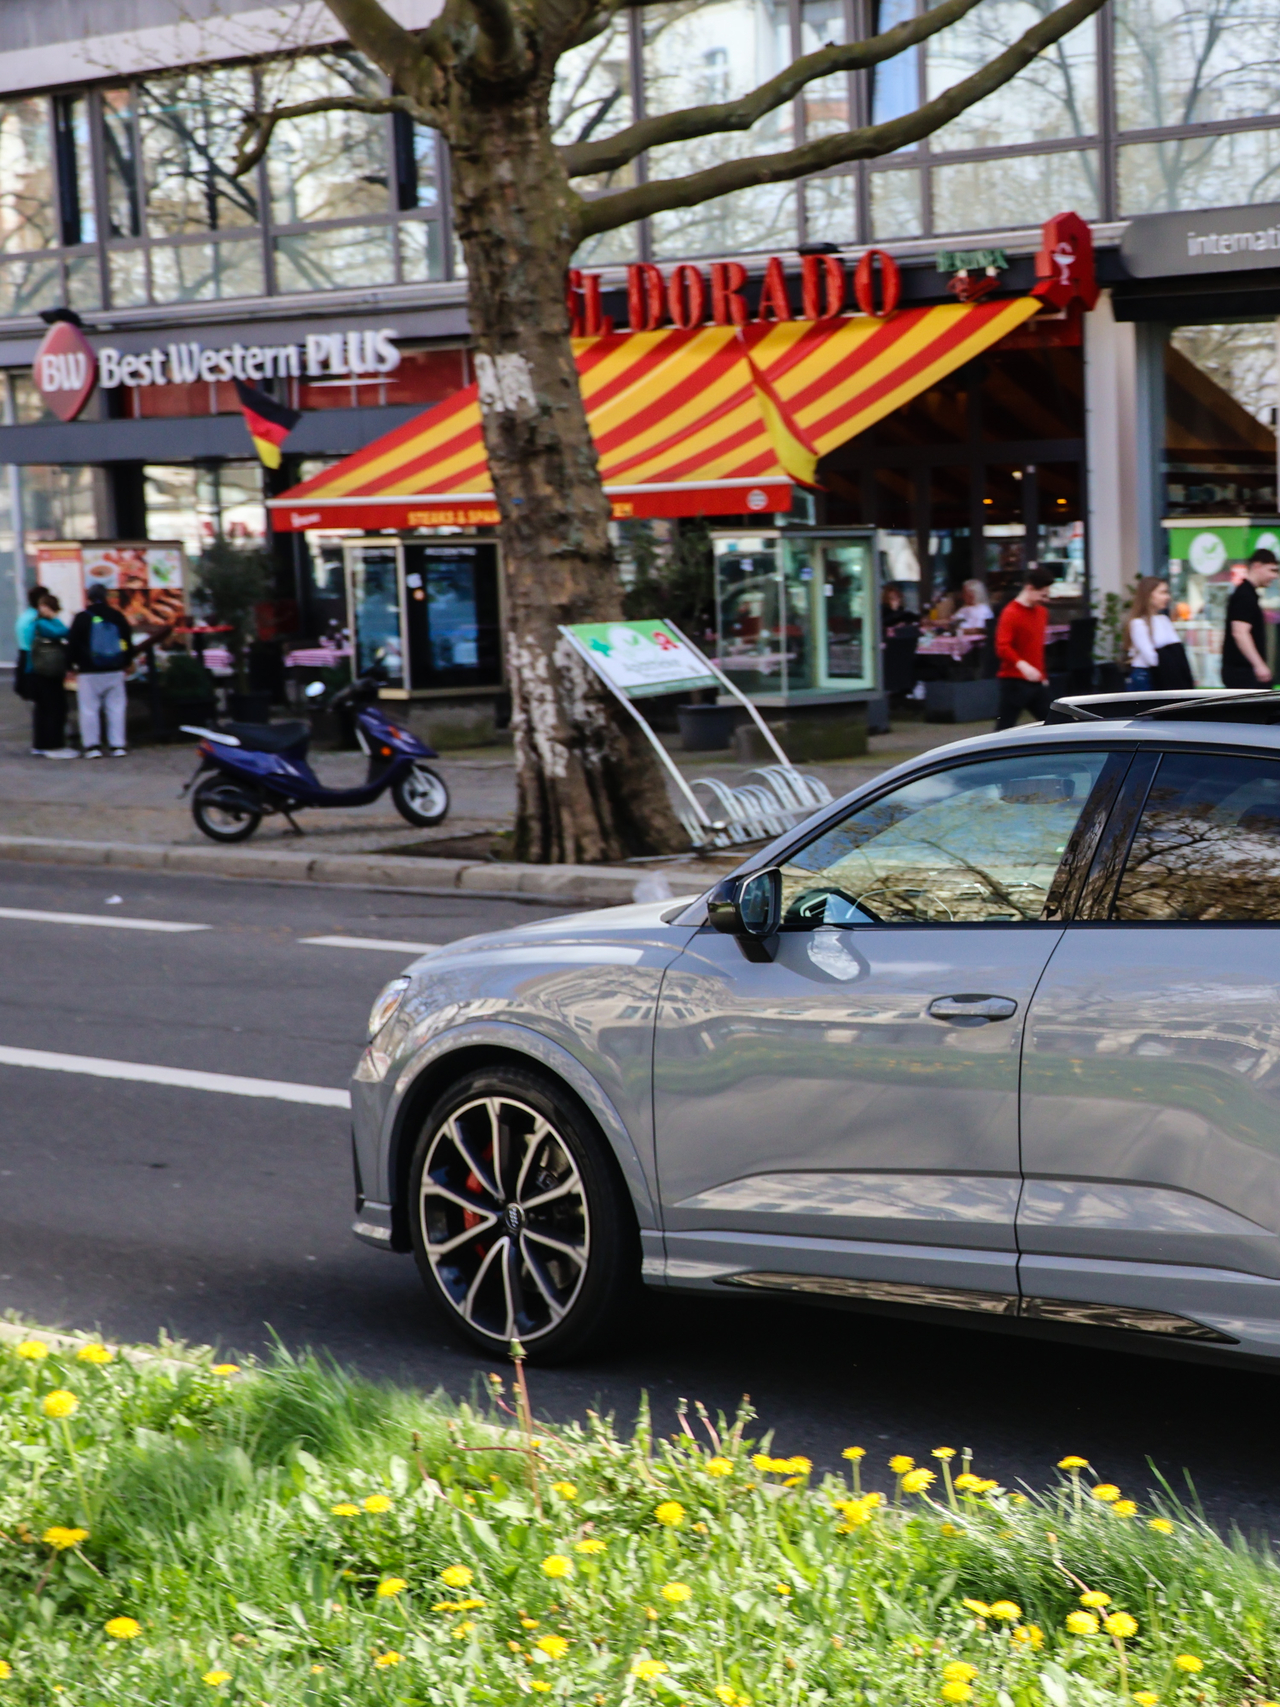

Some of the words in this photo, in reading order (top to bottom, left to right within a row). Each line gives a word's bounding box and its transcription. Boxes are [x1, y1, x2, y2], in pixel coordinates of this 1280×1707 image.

[627, 249, 901, 332] DORADO
[41, 351, 87, 392] BW
[100, 346, 168, 390] Best
[168, 340, 300, 383] Western
[306, 328, 401, 377] PLUS
